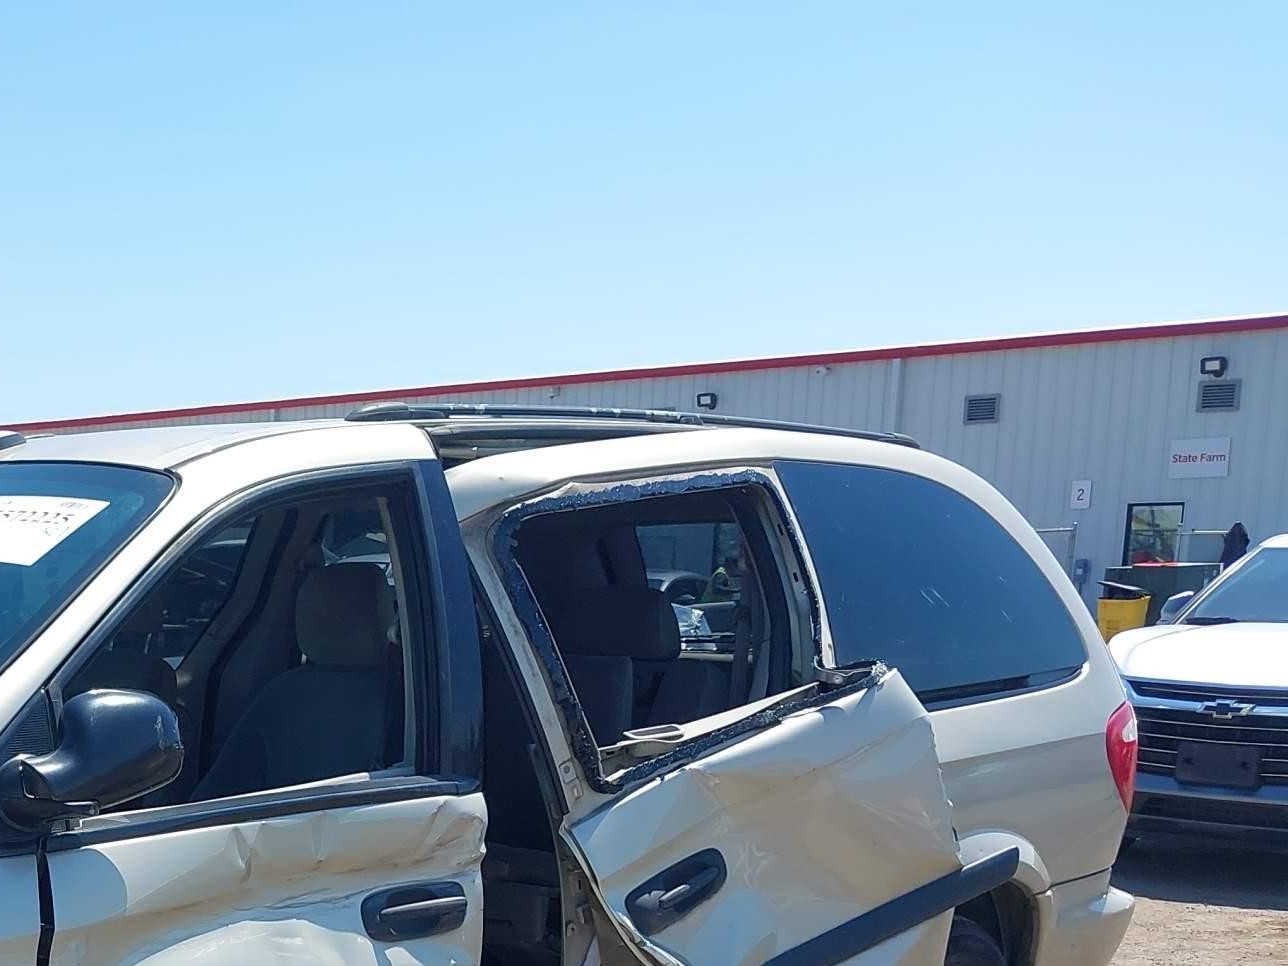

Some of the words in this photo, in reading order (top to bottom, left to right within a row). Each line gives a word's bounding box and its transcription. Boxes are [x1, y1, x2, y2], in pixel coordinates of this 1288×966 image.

[1172, 454, 1197, 463] State
[1200, 453, 1226, 462] Farm
[1077, 488, 1085, 501] 2
